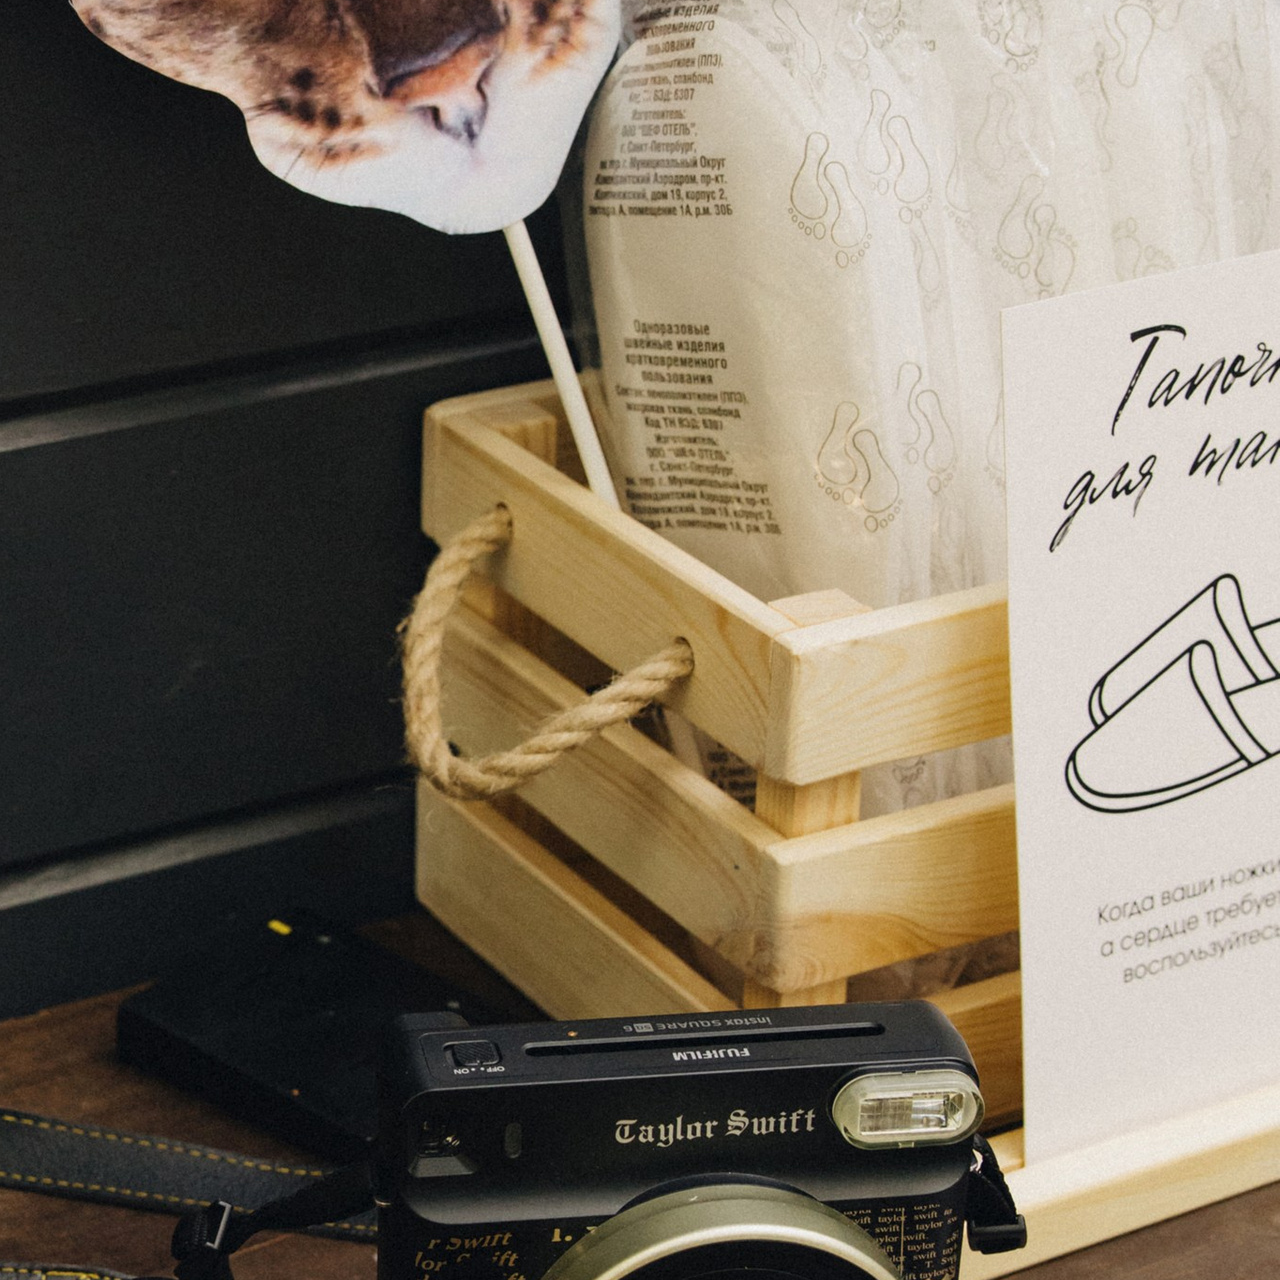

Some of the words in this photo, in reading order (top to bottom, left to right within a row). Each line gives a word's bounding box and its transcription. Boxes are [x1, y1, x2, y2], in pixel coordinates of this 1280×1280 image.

[699, 155, 726, 171] Округ
[633, 319, 710, 336] Одноразовые
[676, 340, 726, 354] изделия
[625, 353, 728, 370] кратковременного
[641, 370, 714, 384] пользования
[1049, 454, 1157, 553] для
[1098, 895, 1155, 926] Когда
[1161, 878, 1214, 906] ваши
[1100, 941, 1114, 958] а
[1120, 915, 1199, 951] сердце
[657, 1019, 720, 1031] SQUARE
[724, 1016, 773, 1026] instax
[672, 1047, 751, 1062] FUJIFILM
[453, 1067, 470, 1075] ON
[614, 1114, 719, 1148] Taylor
[725, 1107, 817, 1137] Swift
